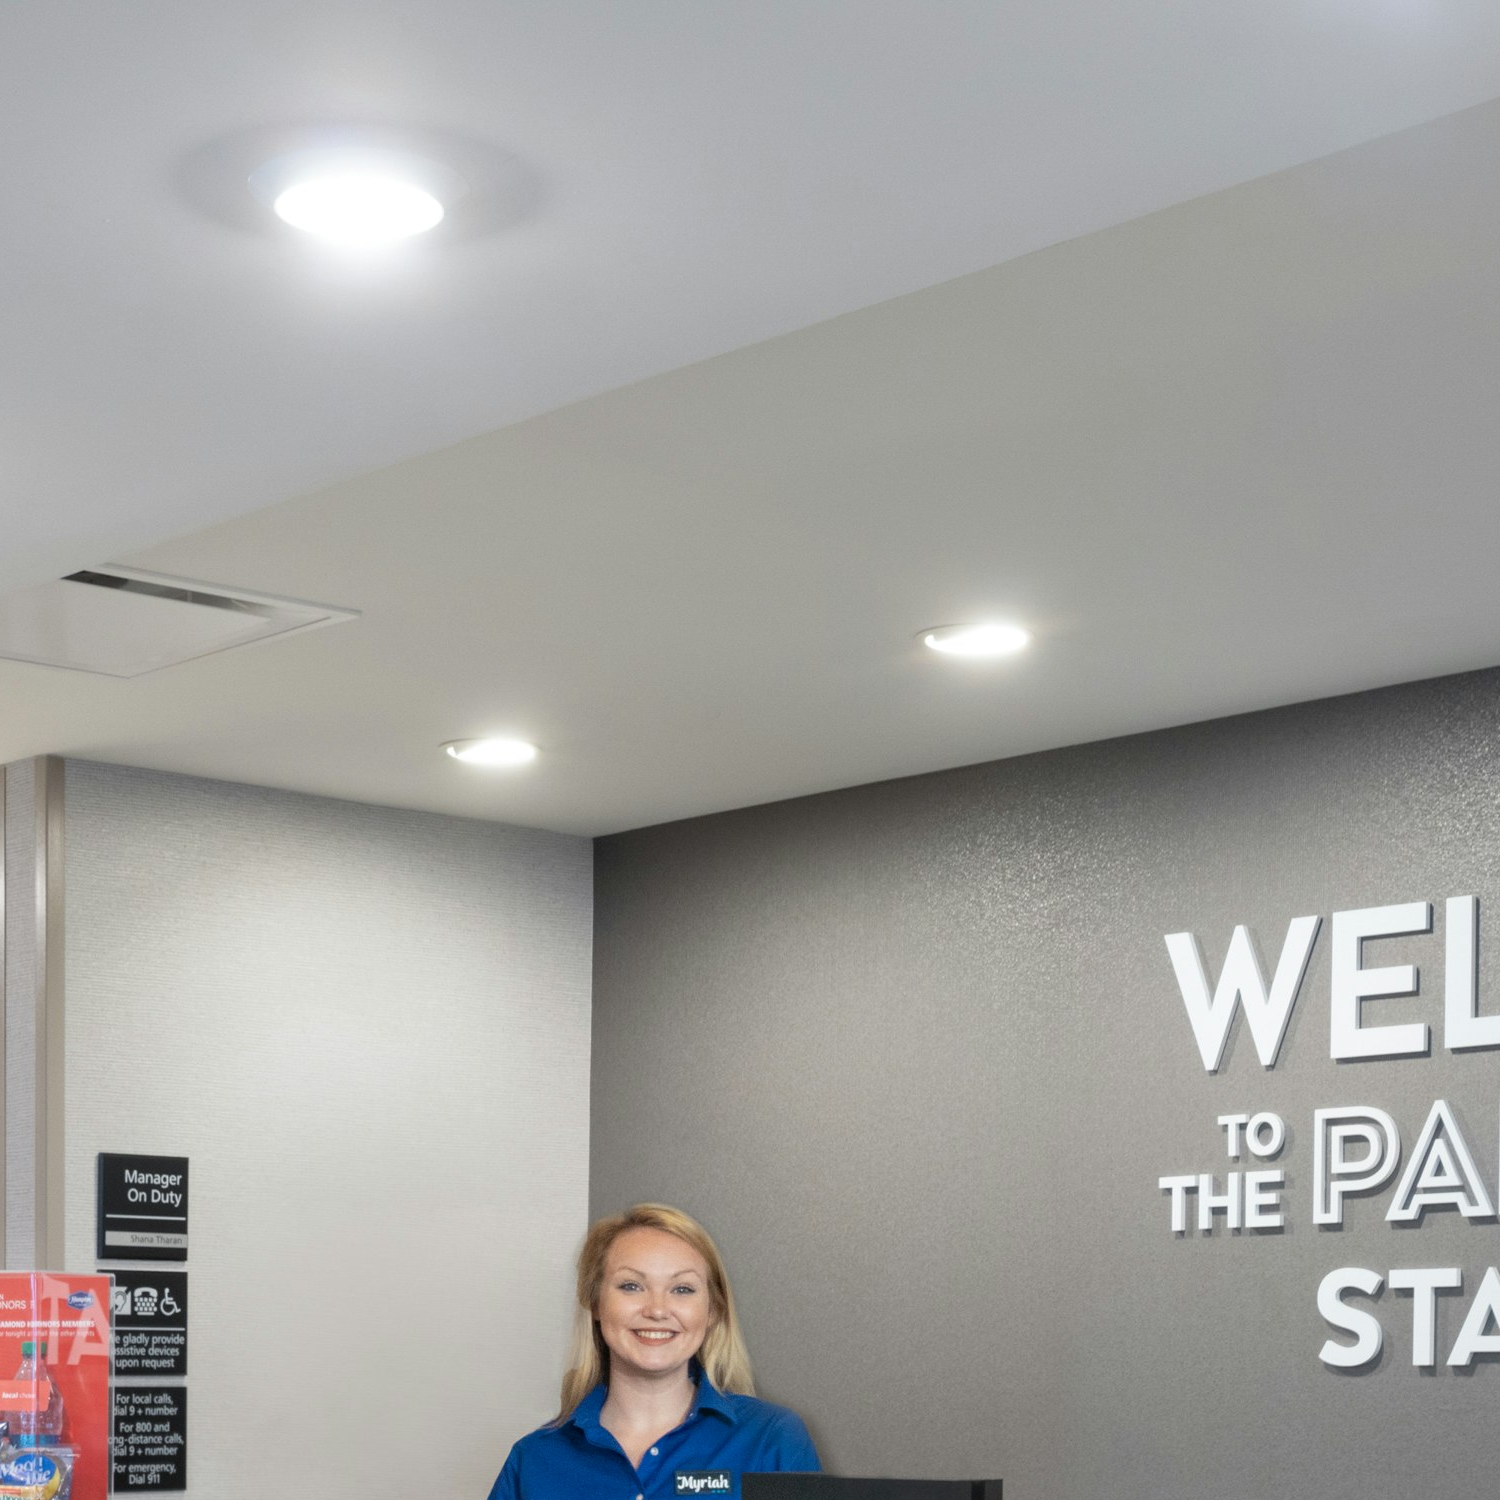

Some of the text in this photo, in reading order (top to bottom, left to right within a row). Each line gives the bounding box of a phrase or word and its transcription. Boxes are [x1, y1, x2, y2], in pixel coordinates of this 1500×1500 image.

[1217, 1112, 1286, 1157] TO
[124, 1169, 182, 1188] Manager
[127, 1188, 182, 1207] On Duty
[1159, 1169, 1285, 1232] THE
[122, 1333, 150, 1347] gladly
[151, 1333, 185, 1347] provide
[148, 1345, 180, 1356] devices
[116, 1358, 175, 1370] upon request
[116, 1393, 174, 1405] For local calls,
[129, 1406, 136, 1416] 9
[145, 1406, 178, 1416] number
[120, 1422, 170, 1433] For 800 and
[107, 1433, 184, 1447] ong-distance calls,
[129, 1446, 135, 1456] 9
[145, 1446, 178, 1456] number
[128, 1463, 177, 1475] emergency,
[129, 1474, 160, 1485] Dial 911
[677, 1474, 730, 1493] Myriah
